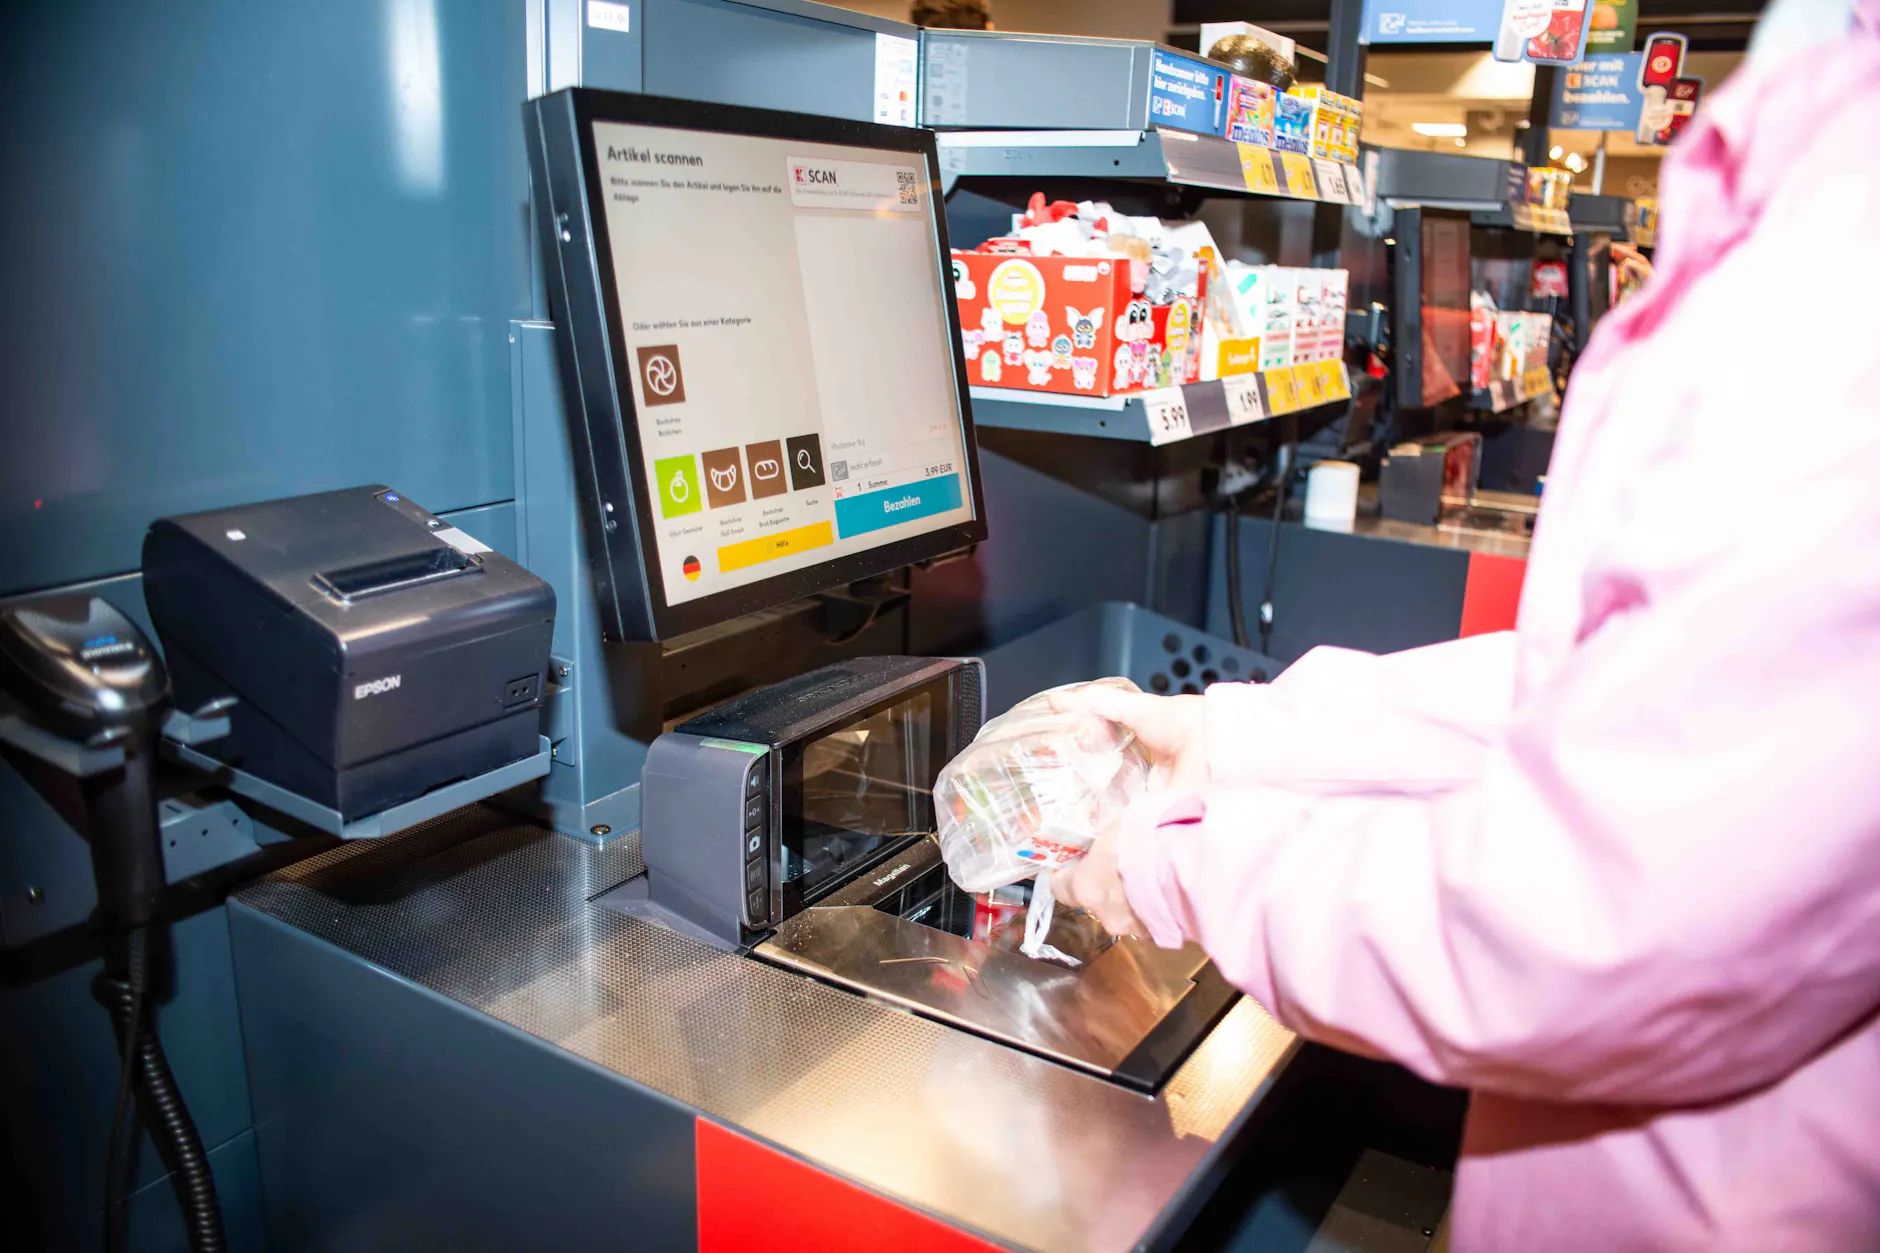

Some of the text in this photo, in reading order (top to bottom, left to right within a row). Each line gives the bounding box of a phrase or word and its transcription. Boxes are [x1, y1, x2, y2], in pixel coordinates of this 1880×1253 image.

[1232, 125, 1270, 147] mentos
[1276, 135, 1308, 154] mentos
[607, 146, 703, 167] Artikel scannen
[610, 177, 629, 186] Bitte
[631, 179, 658, 188] scannen
[660, 179, 671, 188] Sie
[673, 180, 685, 189] den
[687, 181, 708, 190] Artikel
[710, 182, 722, 191] und
[723, 183, 740, 194] legen
[741, 184, 750, 192] Sie
[762, 185, 772, 193] auf
[773, 186, 782, 194] die
[808, 170, 837, 184] SCAN
[633, 321, 650, 331] Oder
[653, 321, 677, 330] wählen
[679, 320, 689, 328] Sie
[704, 319, 719, 327] einer
[721, 317, 751, 327] Kategorie
[1240, 390, 1258, 412] 1.99
[1161, 405, 1185, 431] 5.99
[850, 461, 864, 471] nicht
[868, 480, 888, 489] Summe
[925, 466, 939, 477] 3,99
[939, 463, 952, 474] EUR
[762, 507, 783, 517] Backshop
[883, 496, 921, 513] Bezahlen
[776, 540, 789, 549] Hilfe
[355, 675, 401, 699] EPSON
[873, 864, 911, 886] Magellan
